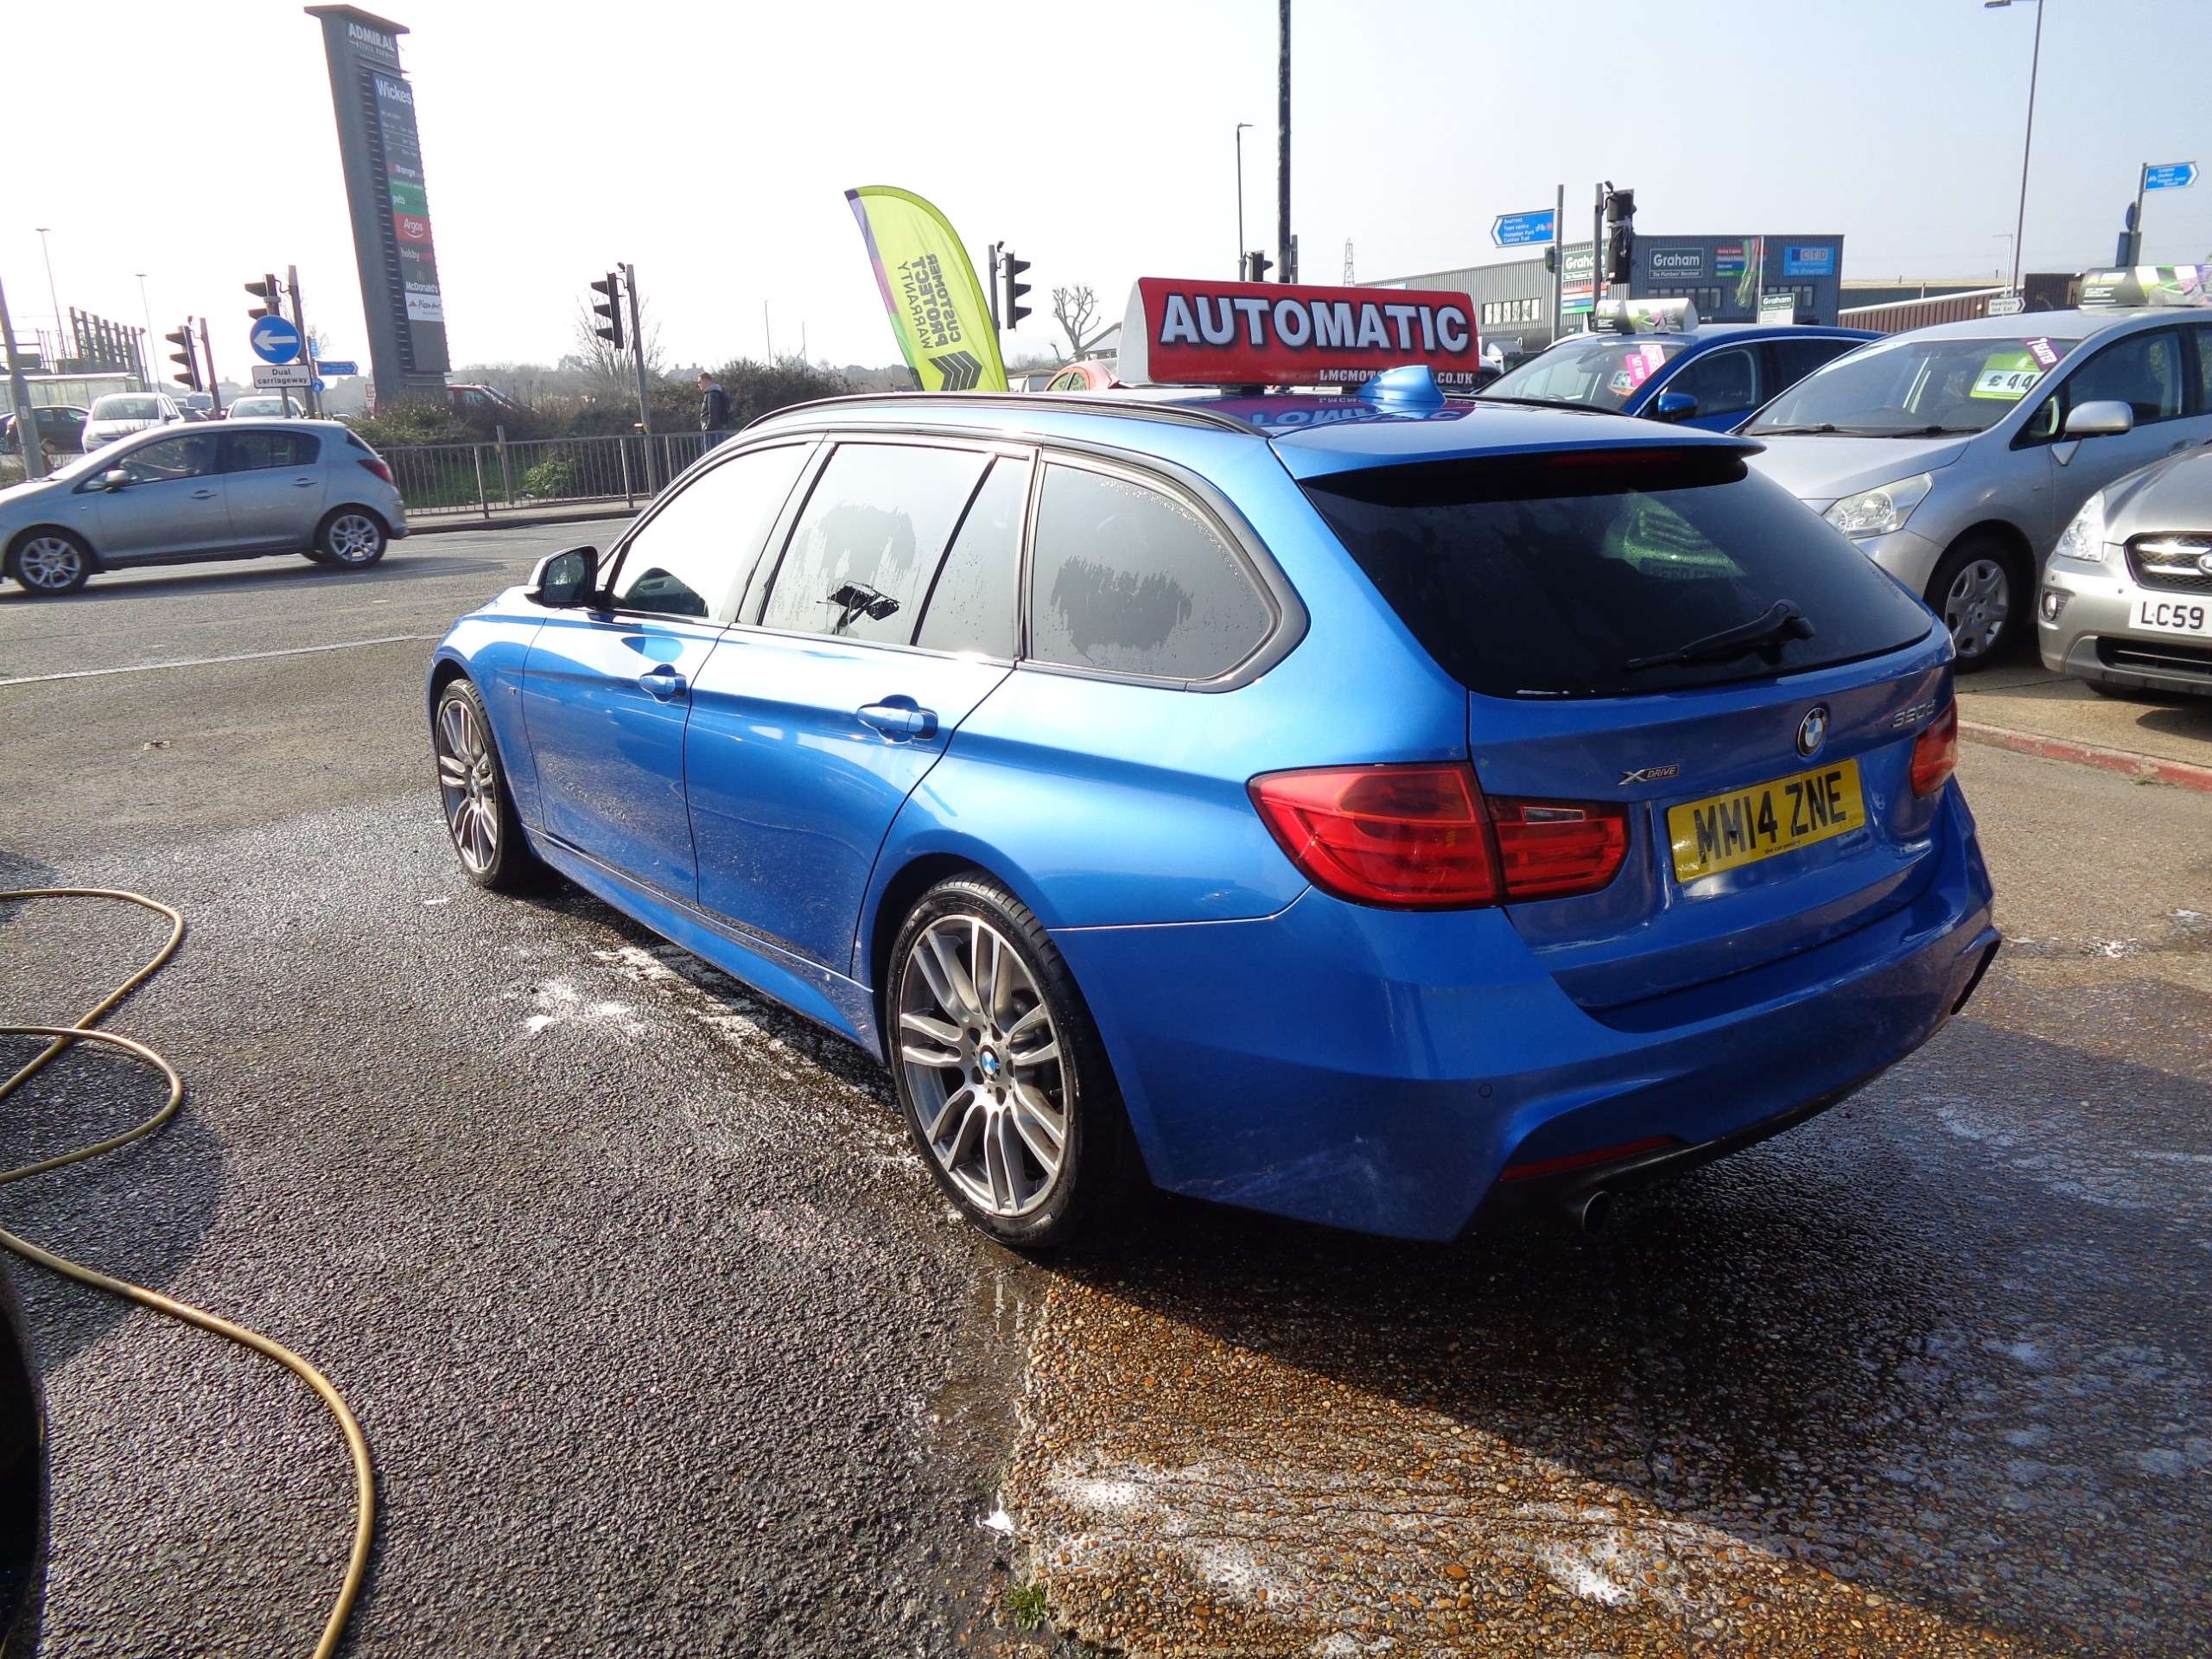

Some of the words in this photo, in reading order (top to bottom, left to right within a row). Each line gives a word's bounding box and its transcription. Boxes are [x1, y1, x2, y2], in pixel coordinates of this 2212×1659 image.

[348, 22, 395, 52] ADMIRAL
[375, 79, 412, 105] Wickes
[404, 218, 423, 233] Argos
[401, 247, 420, 262] hobby
[1653, 253, 1700, 267] Graham
[1763, 296, 1792, 305] Graham
[1160, 294, 1471, 353] AUTOMATIC
[257, 377, 308, 385] carriageway
[2139, 601, 2205, 630] LC59
[1693, 790, 1778, 865] MM14
[1784, 770, 1847, 838] ZNE
